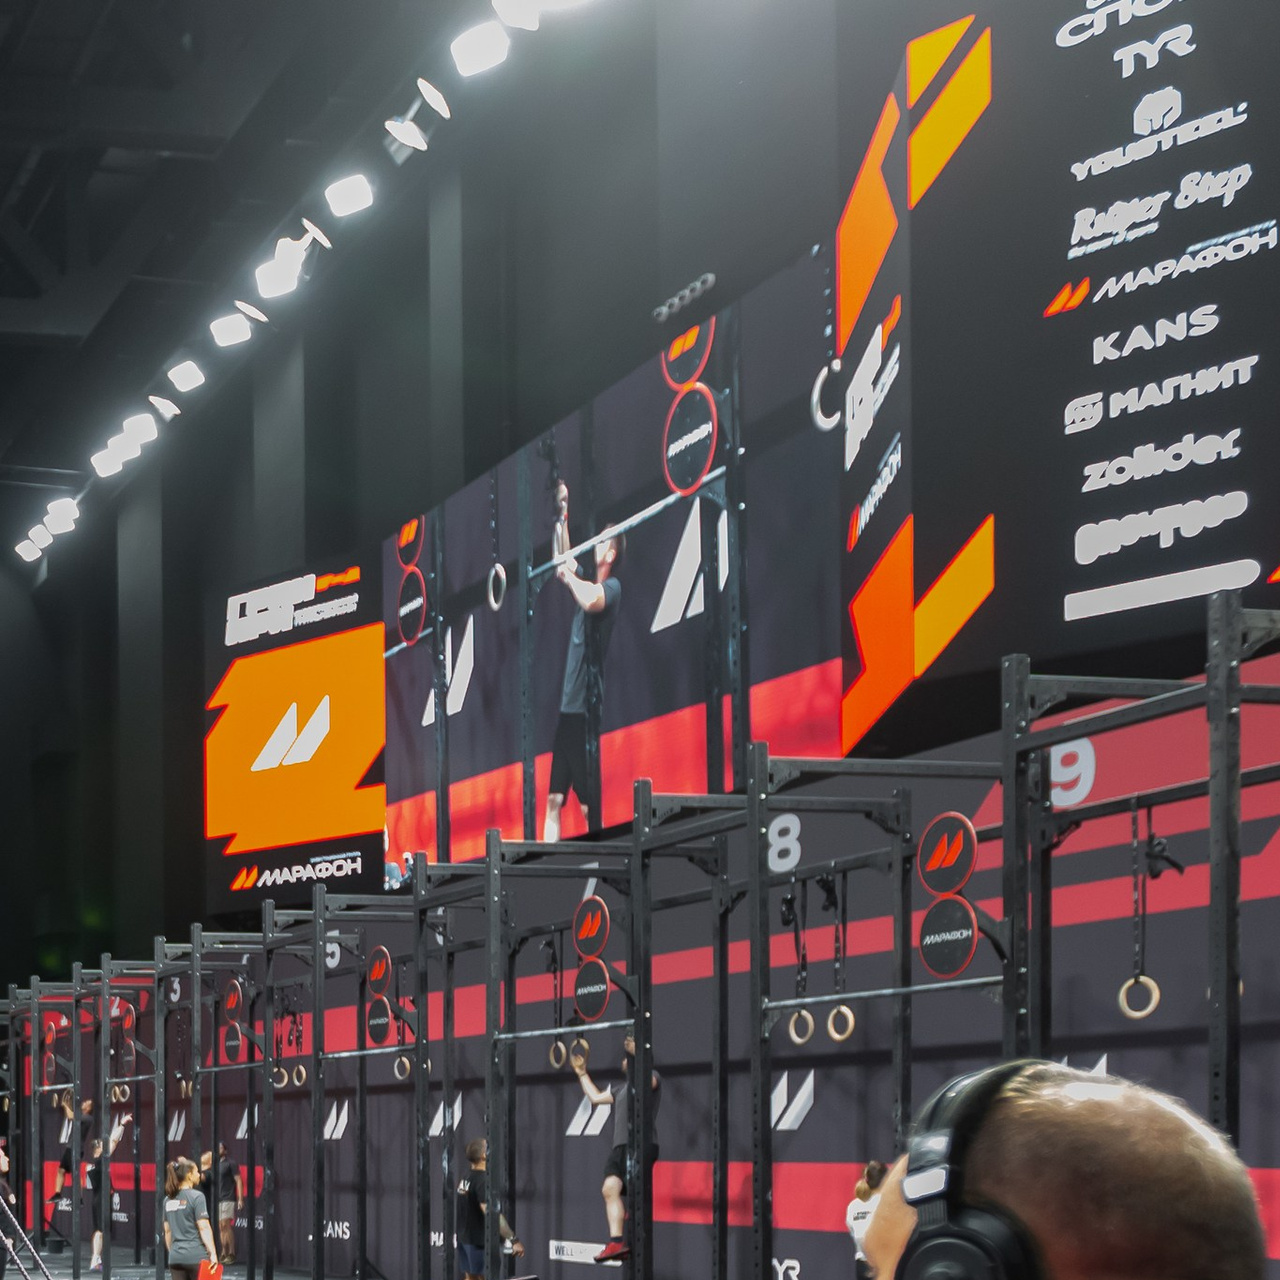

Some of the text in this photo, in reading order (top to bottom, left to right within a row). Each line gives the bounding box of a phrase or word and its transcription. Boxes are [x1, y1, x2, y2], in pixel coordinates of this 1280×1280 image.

[1113, 24, 1197, 78] TYR
[1092, 227, 1278, 303] МАРАФОН
[1092, 304, 1220, 365] KANS
[1108, 354, 1260, 418] МАГНИТ
[1050, 737, 1096, 808] 9
[256, 857, 362, 887] МАРАФОН
[768, 813, 802, 873] 8
[170, 976, 181, 1003] 3
[323, 1219, 351, 1240] ANS
